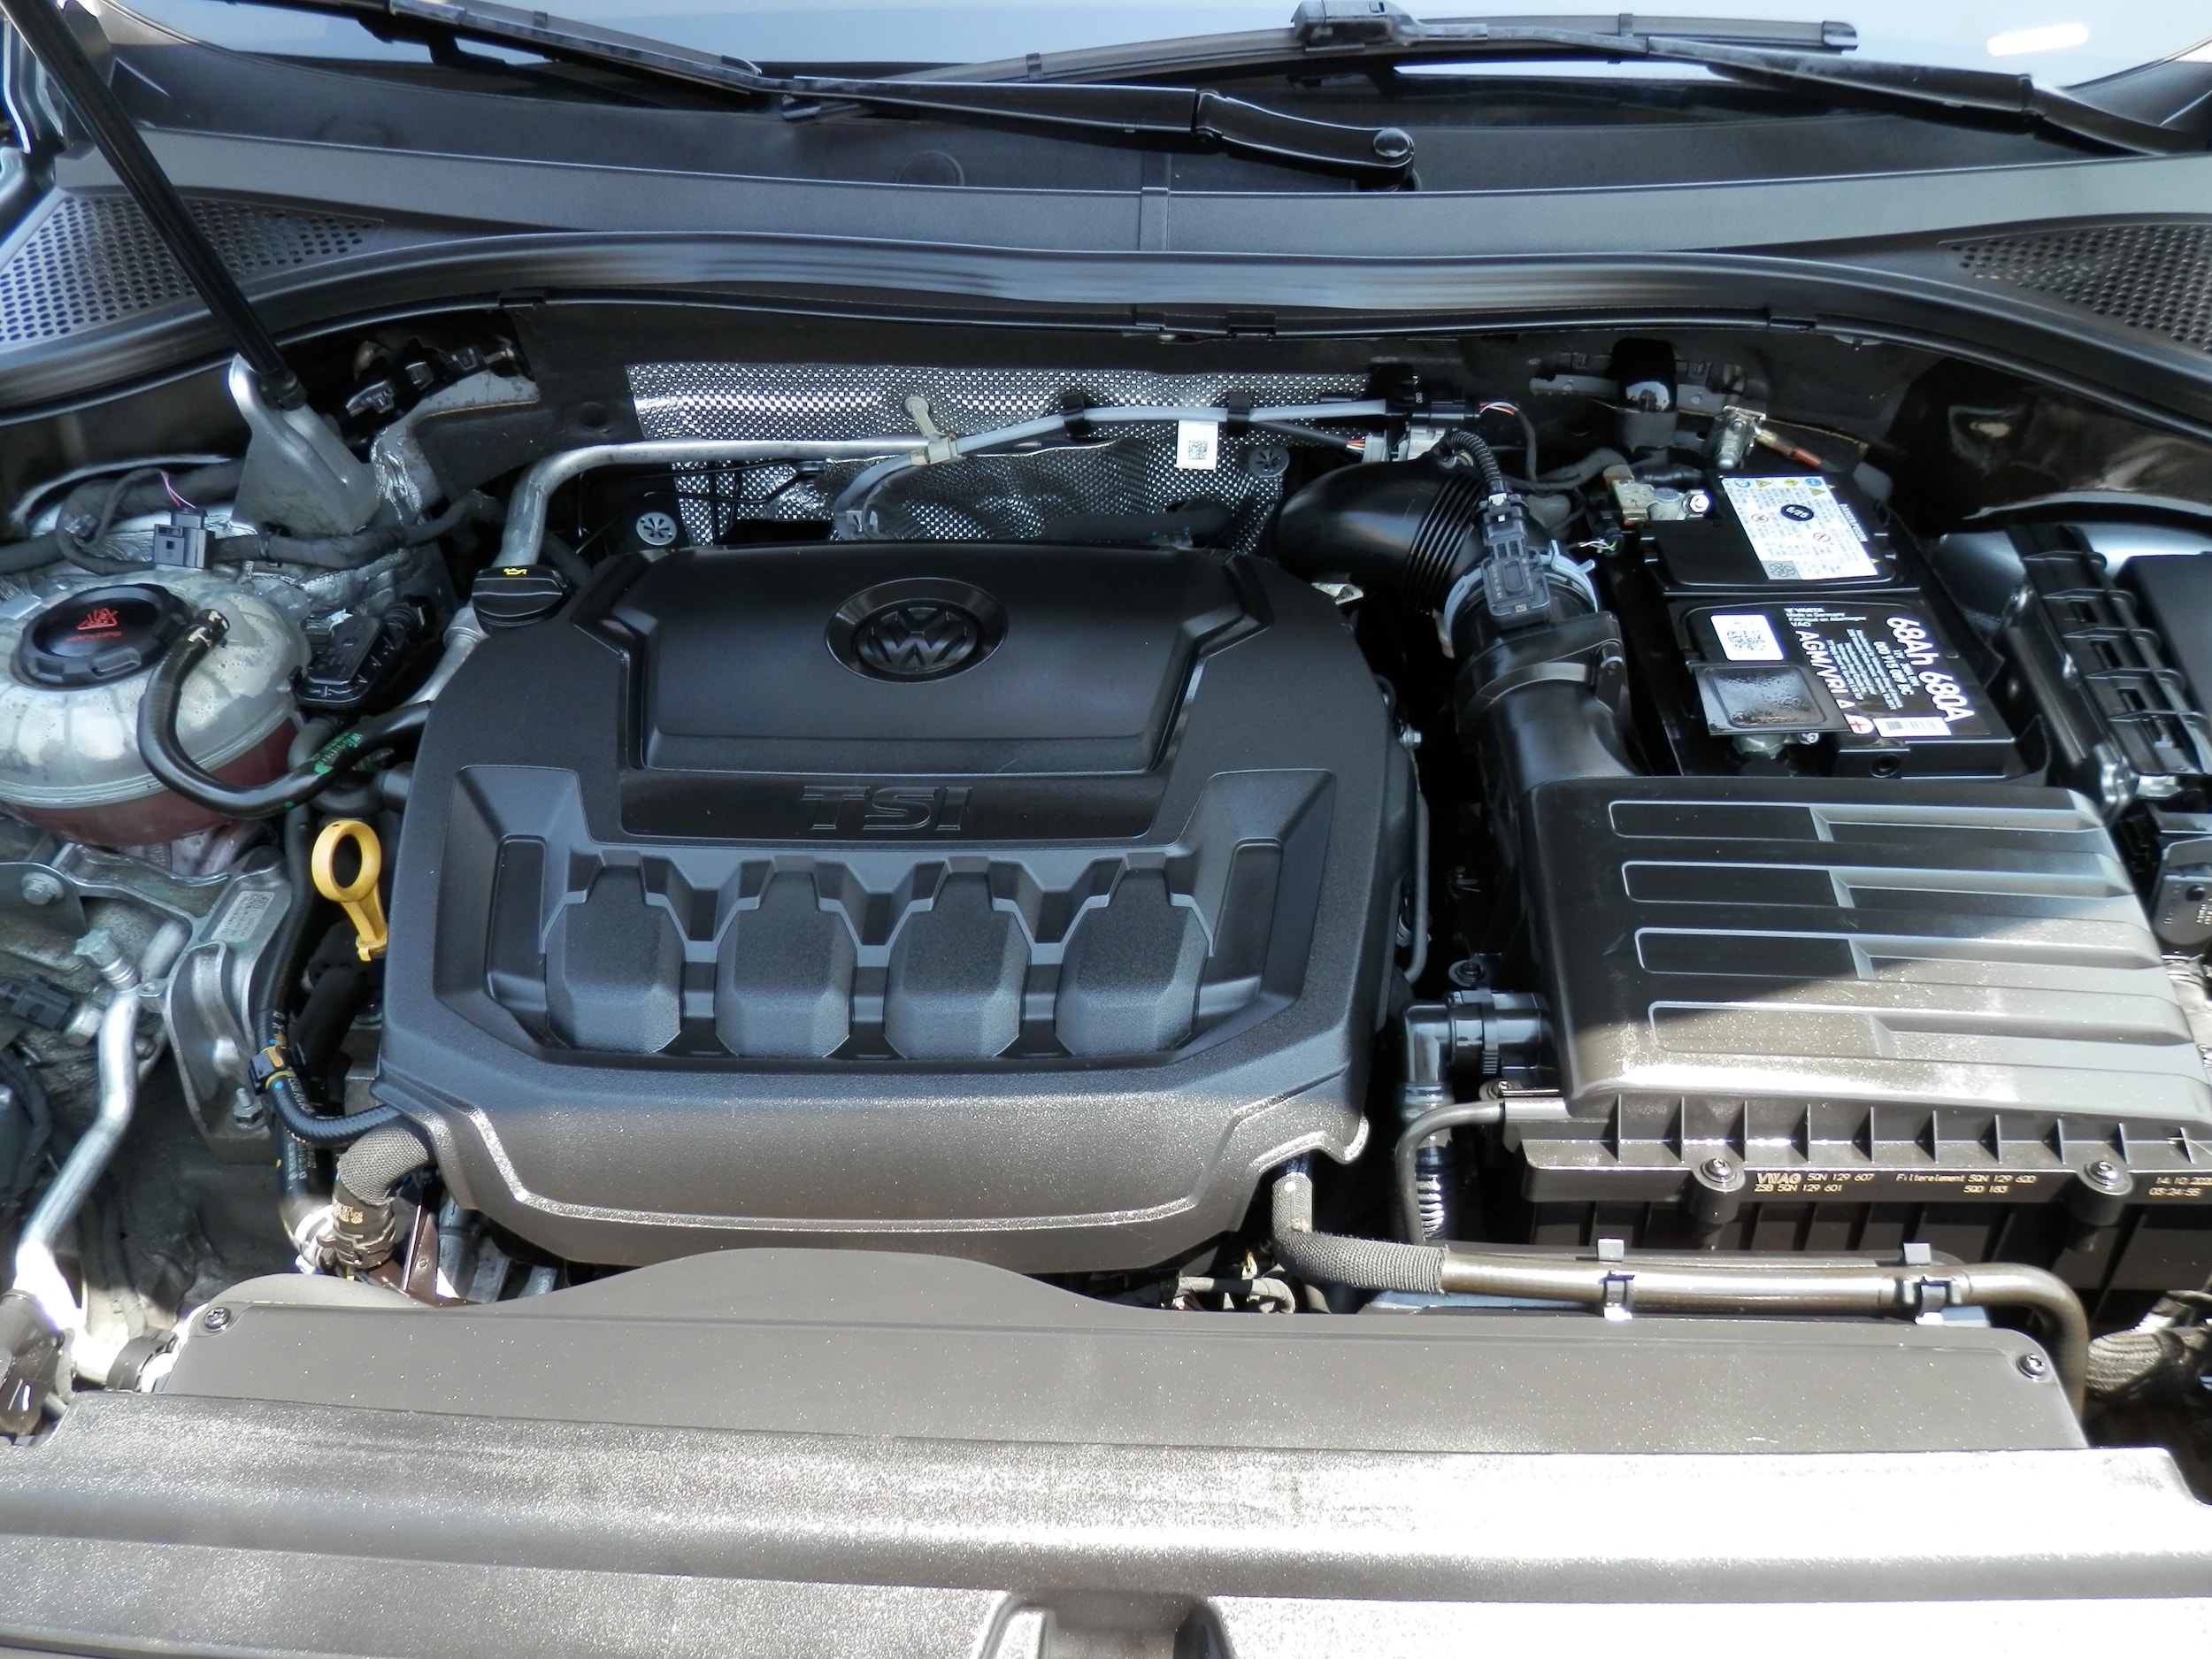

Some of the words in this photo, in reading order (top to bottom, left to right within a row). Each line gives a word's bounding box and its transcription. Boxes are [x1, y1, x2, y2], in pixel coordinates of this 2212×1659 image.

[1886, 617, 1939, 665] 68Ah
[1918, 671, 1975, 722] 680A
[1896, 684, 1915, 695] BC
[801, 786, 972, 830] TSI
[1756, 1172, 1801, 1185] VWAG
[1854, 1173, 1875, 1182] 607
[1895, 1173, 1965, 1182] Filterelement
[1993, 1174, 2013, 1183] 129
